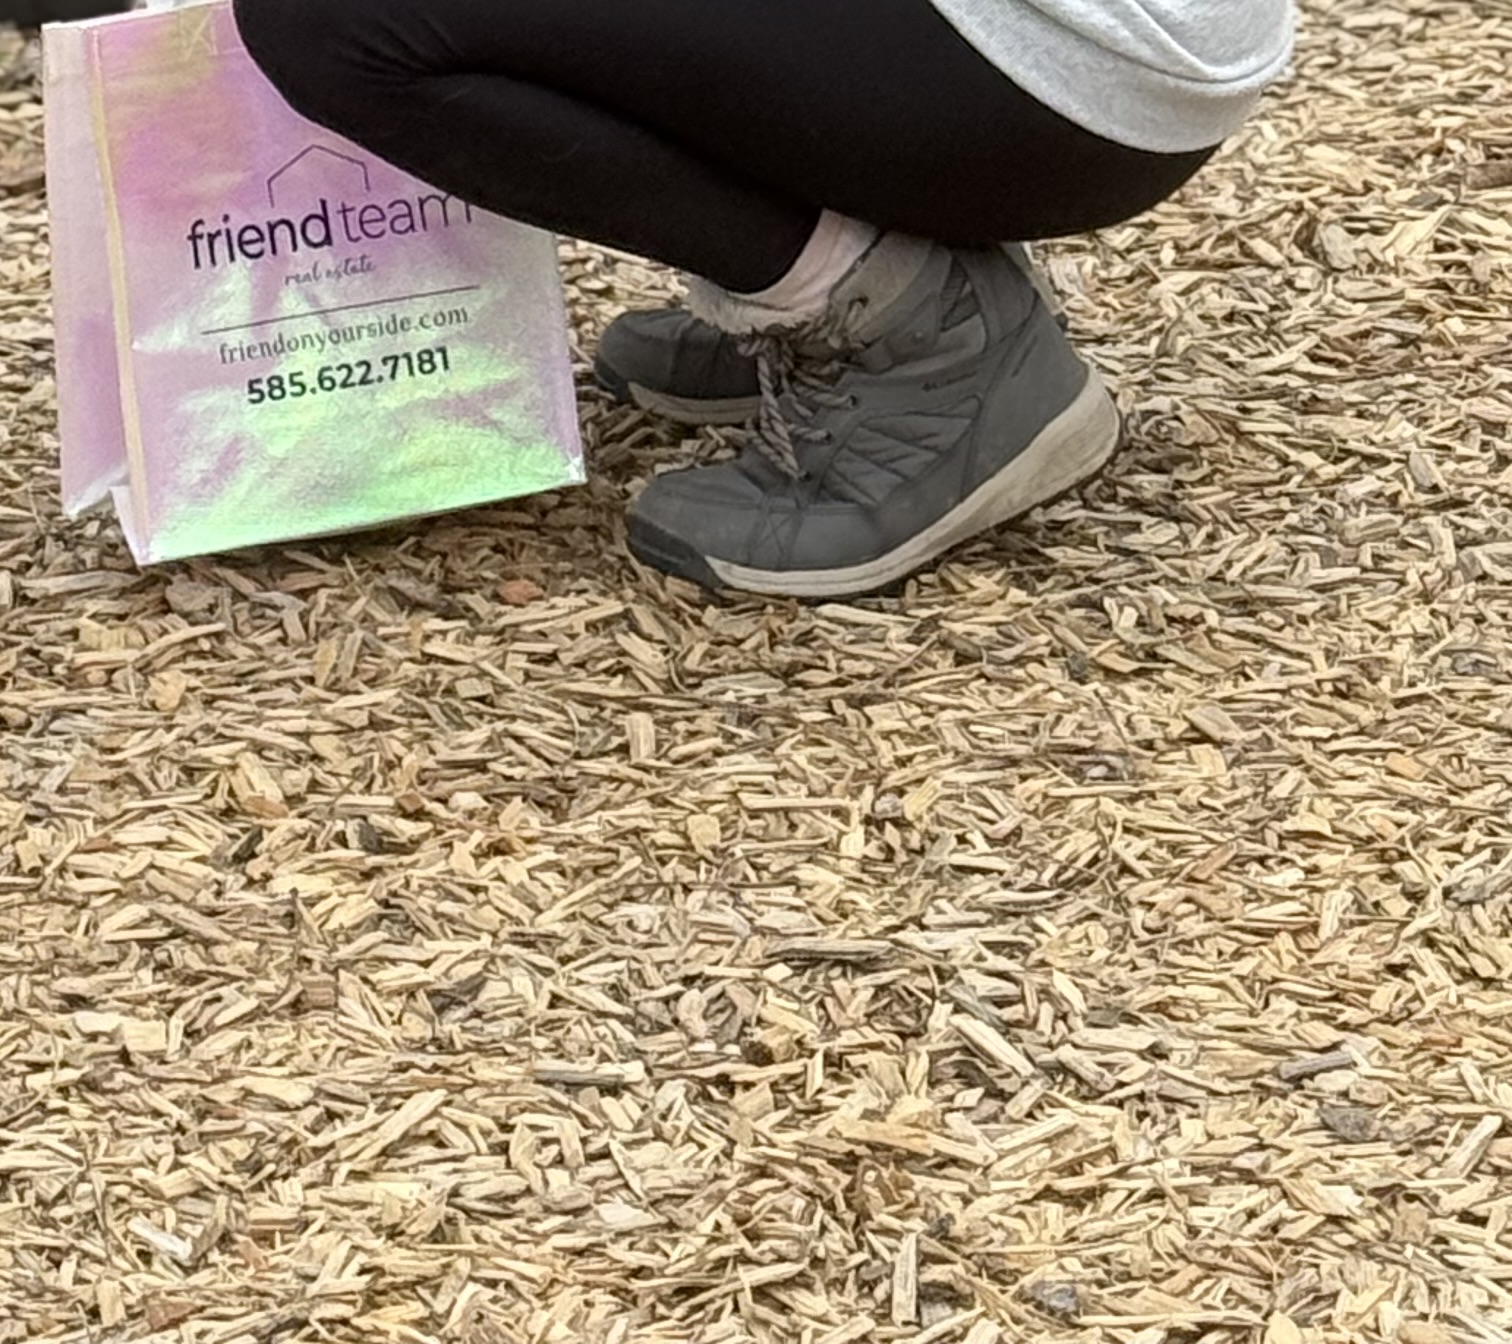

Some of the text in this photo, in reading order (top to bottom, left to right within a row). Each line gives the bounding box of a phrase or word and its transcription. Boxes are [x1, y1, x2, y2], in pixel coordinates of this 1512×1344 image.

[187, 198, 334, 269] friend
[284, 253, 378, 286] real estate
[219, 306, 469, 365] friendonyourside.com
[247, 346, 451, 405] 585.622.7181
